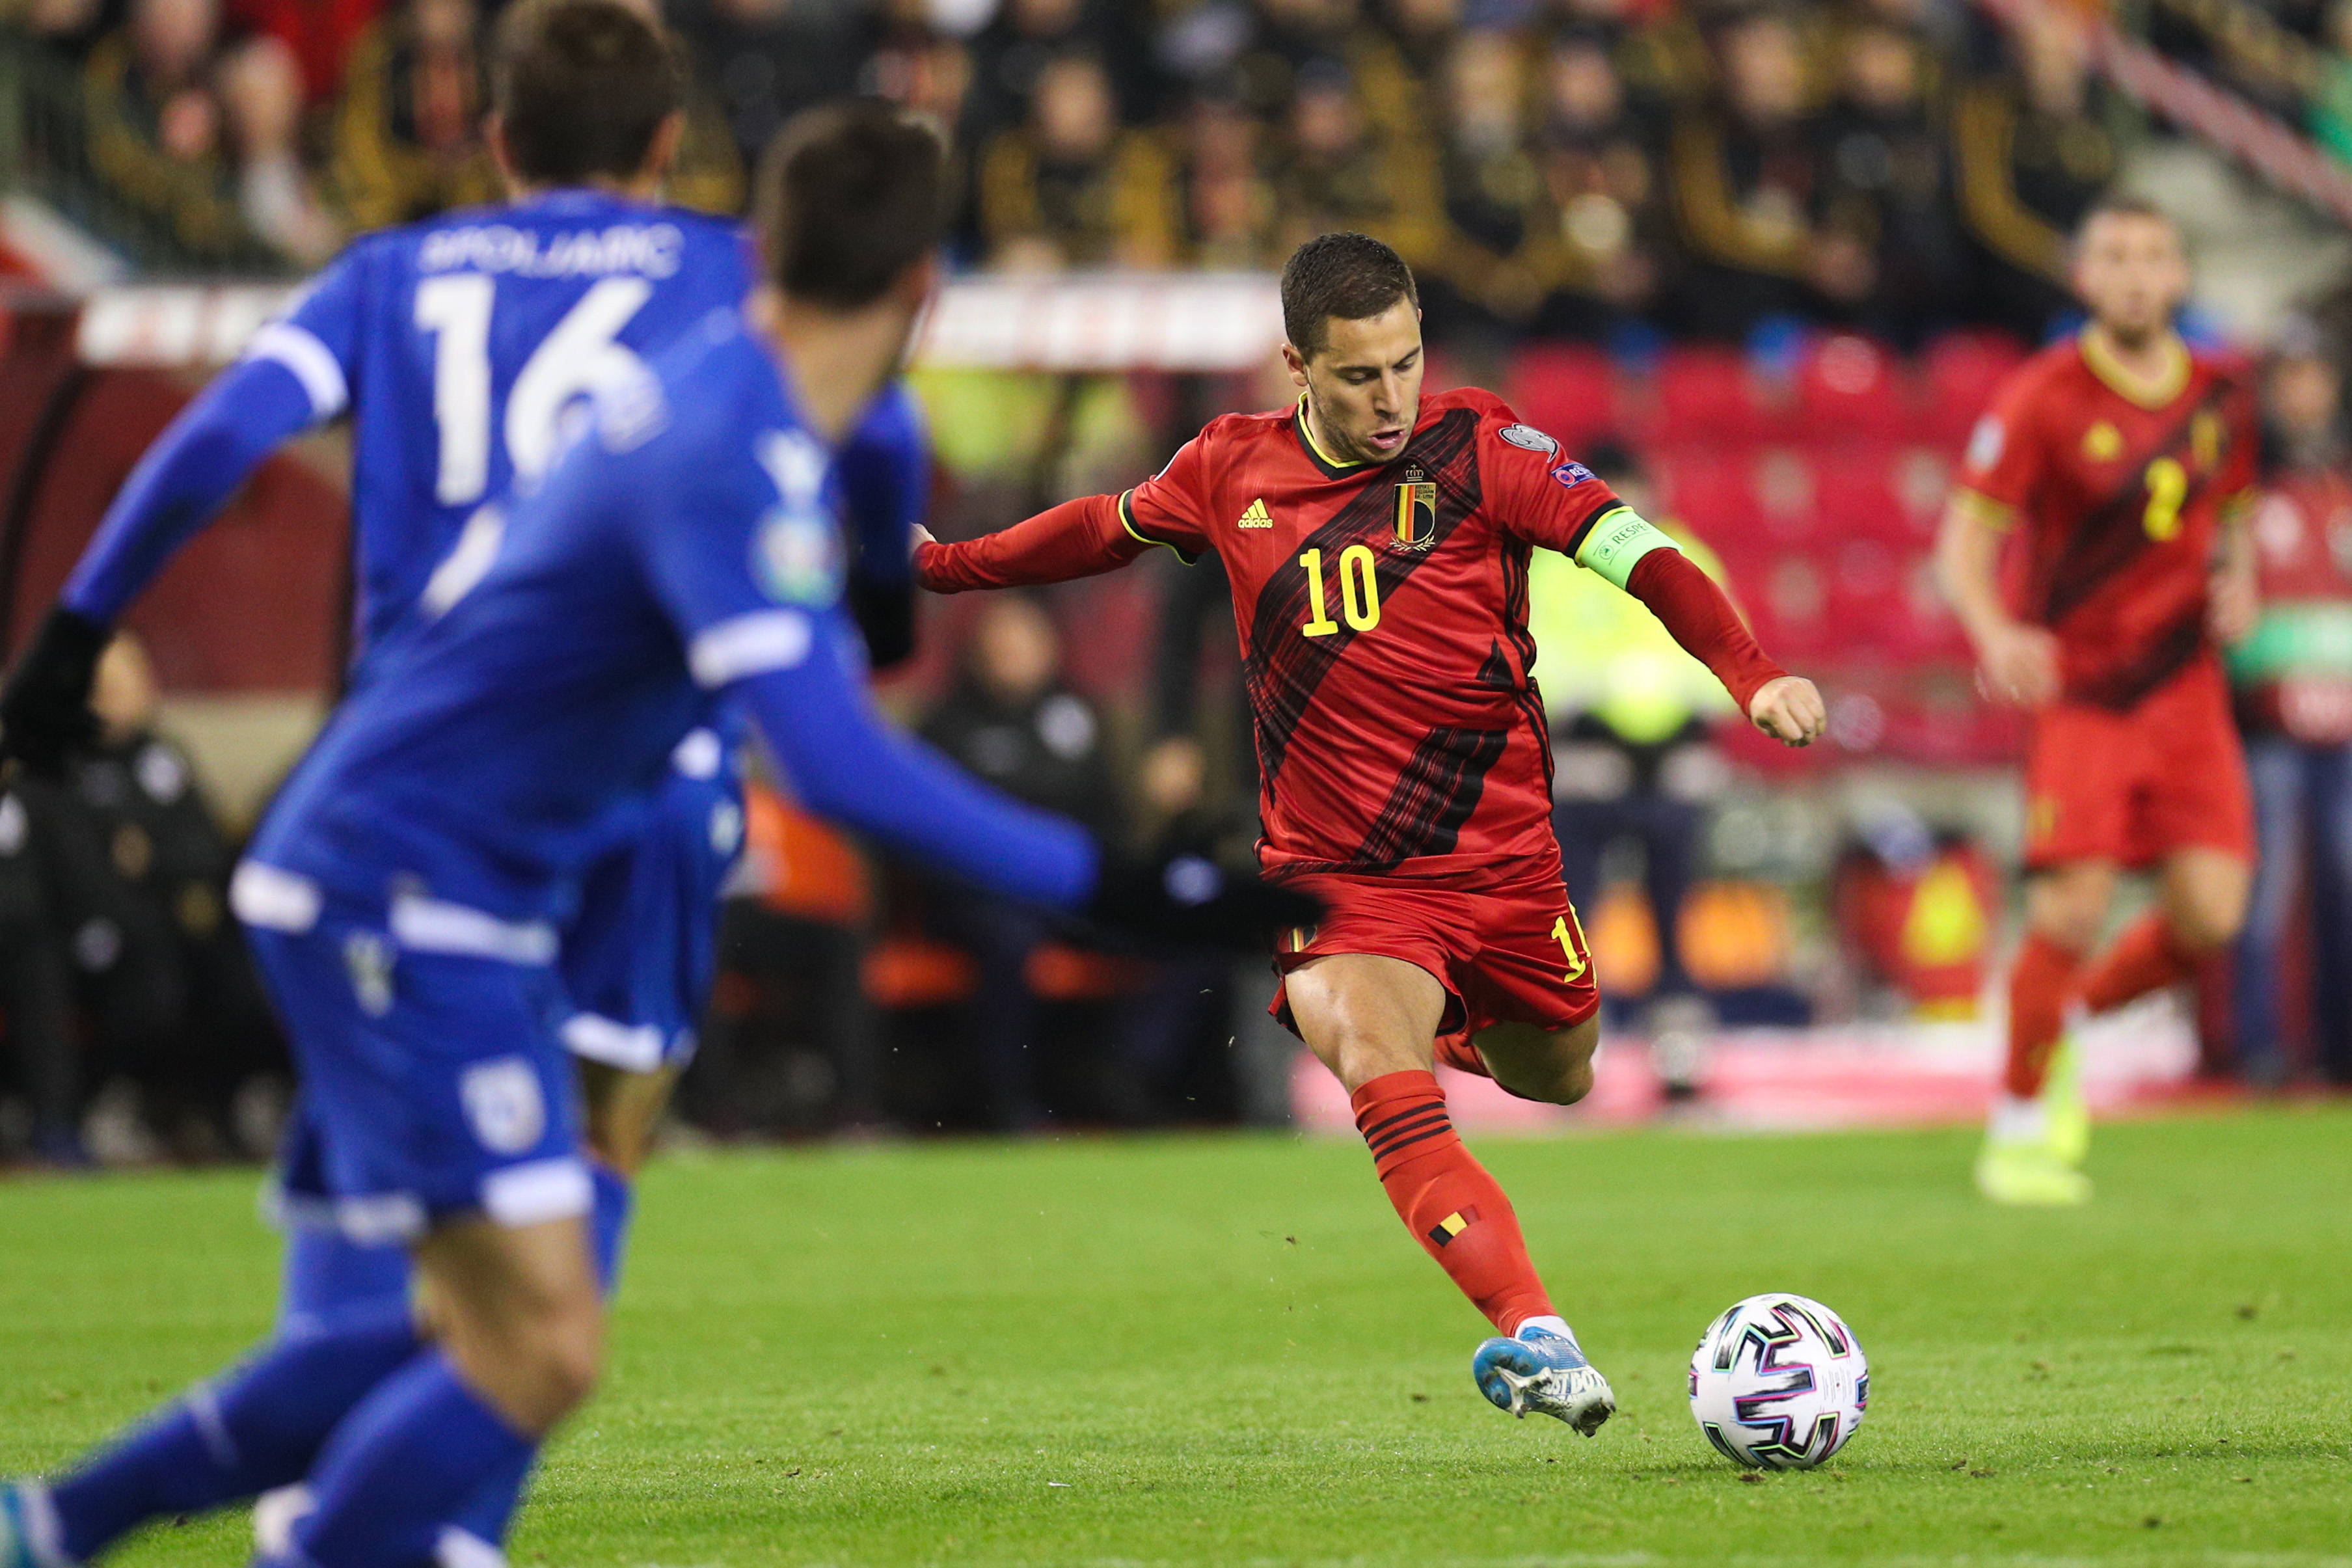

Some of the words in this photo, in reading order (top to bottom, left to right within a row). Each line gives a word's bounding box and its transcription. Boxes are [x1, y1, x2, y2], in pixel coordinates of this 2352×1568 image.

[413, 272, 666, 505] 16
[1237, 517, 1273, 528] adidas
[1612, 522, 1648, 545] RESPE
[2144, 457, 2188, 541] 2
[1299, 545, 1381, 637] 10
